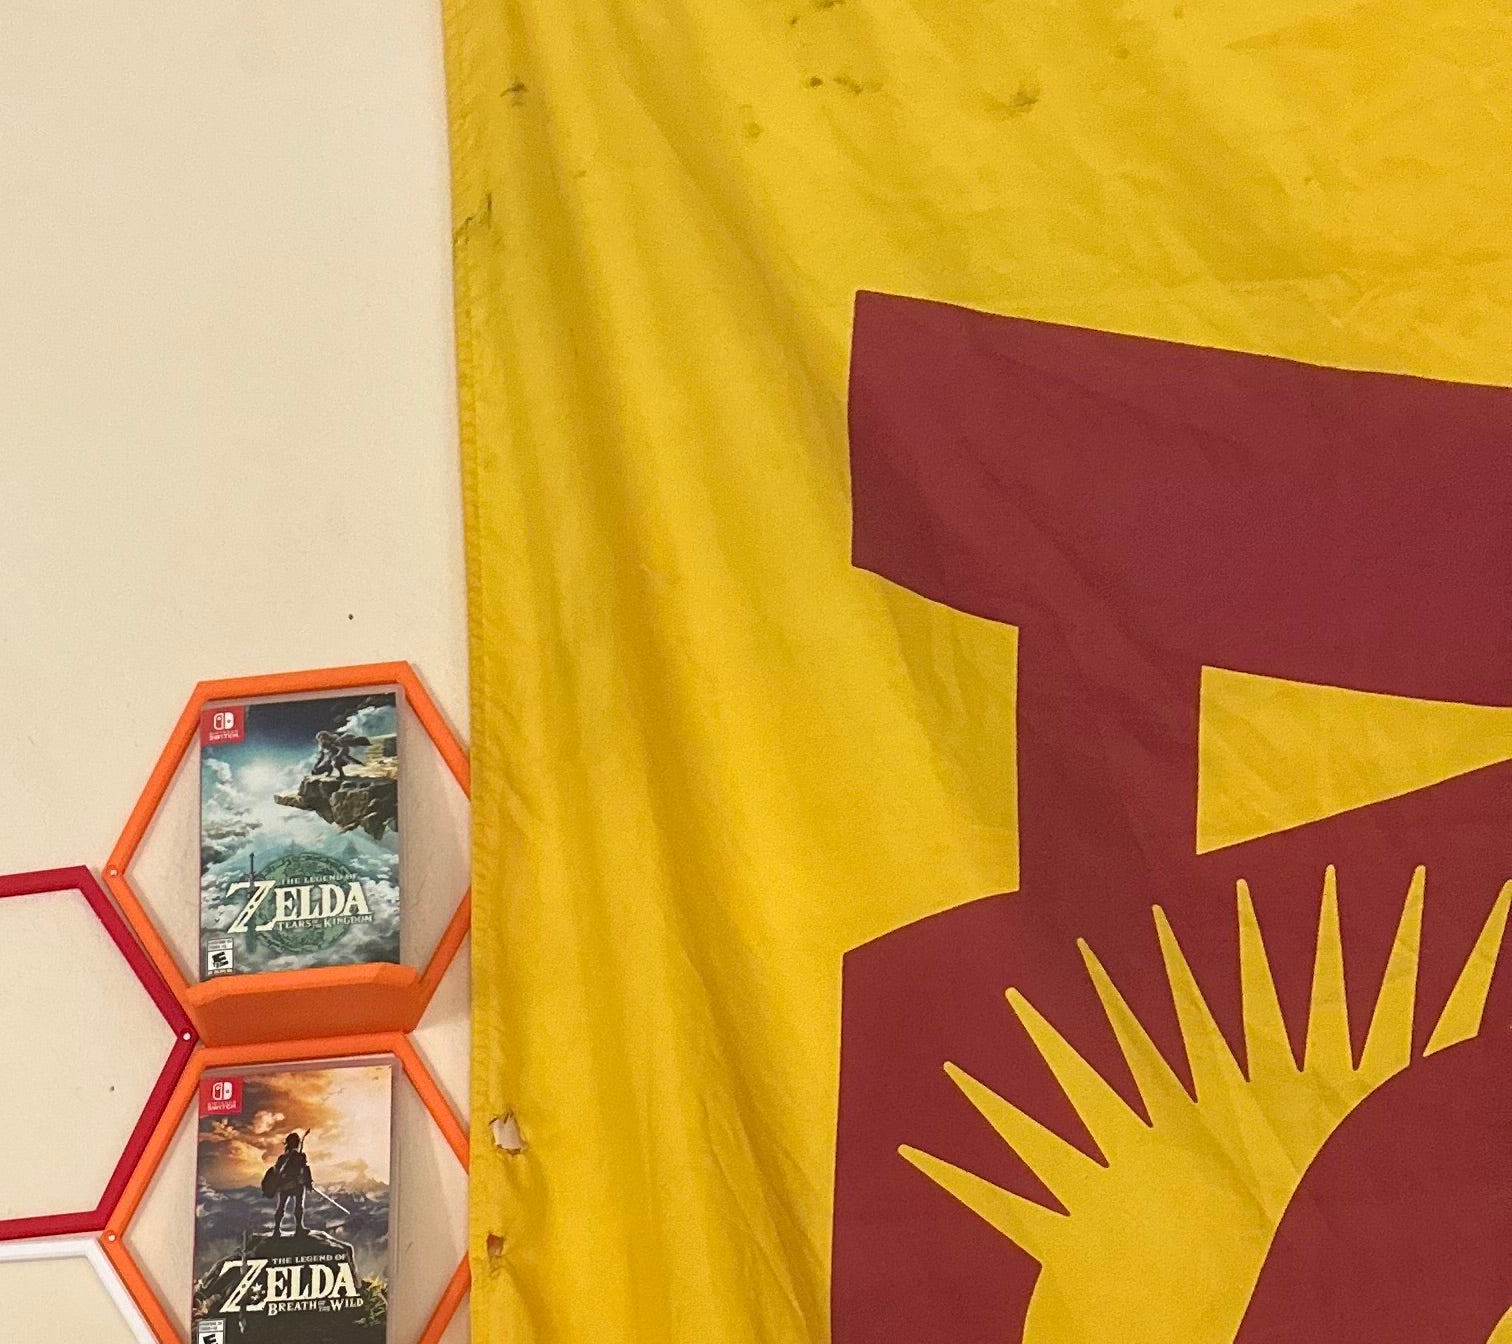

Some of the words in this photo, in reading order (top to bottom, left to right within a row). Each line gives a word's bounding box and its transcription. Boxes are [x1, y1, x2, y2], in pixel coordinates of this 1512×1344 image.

[226, 881, 373, 934] ZELDA
[295, 1254, 333, 1263] LEGEND
[335, 1253, 347, 1261] OF
[219, 1259, 360, 1313] ZELDA
[268, 1300, 317, 1316] BREATH
[330, 1298, 364, 1311] WILD
